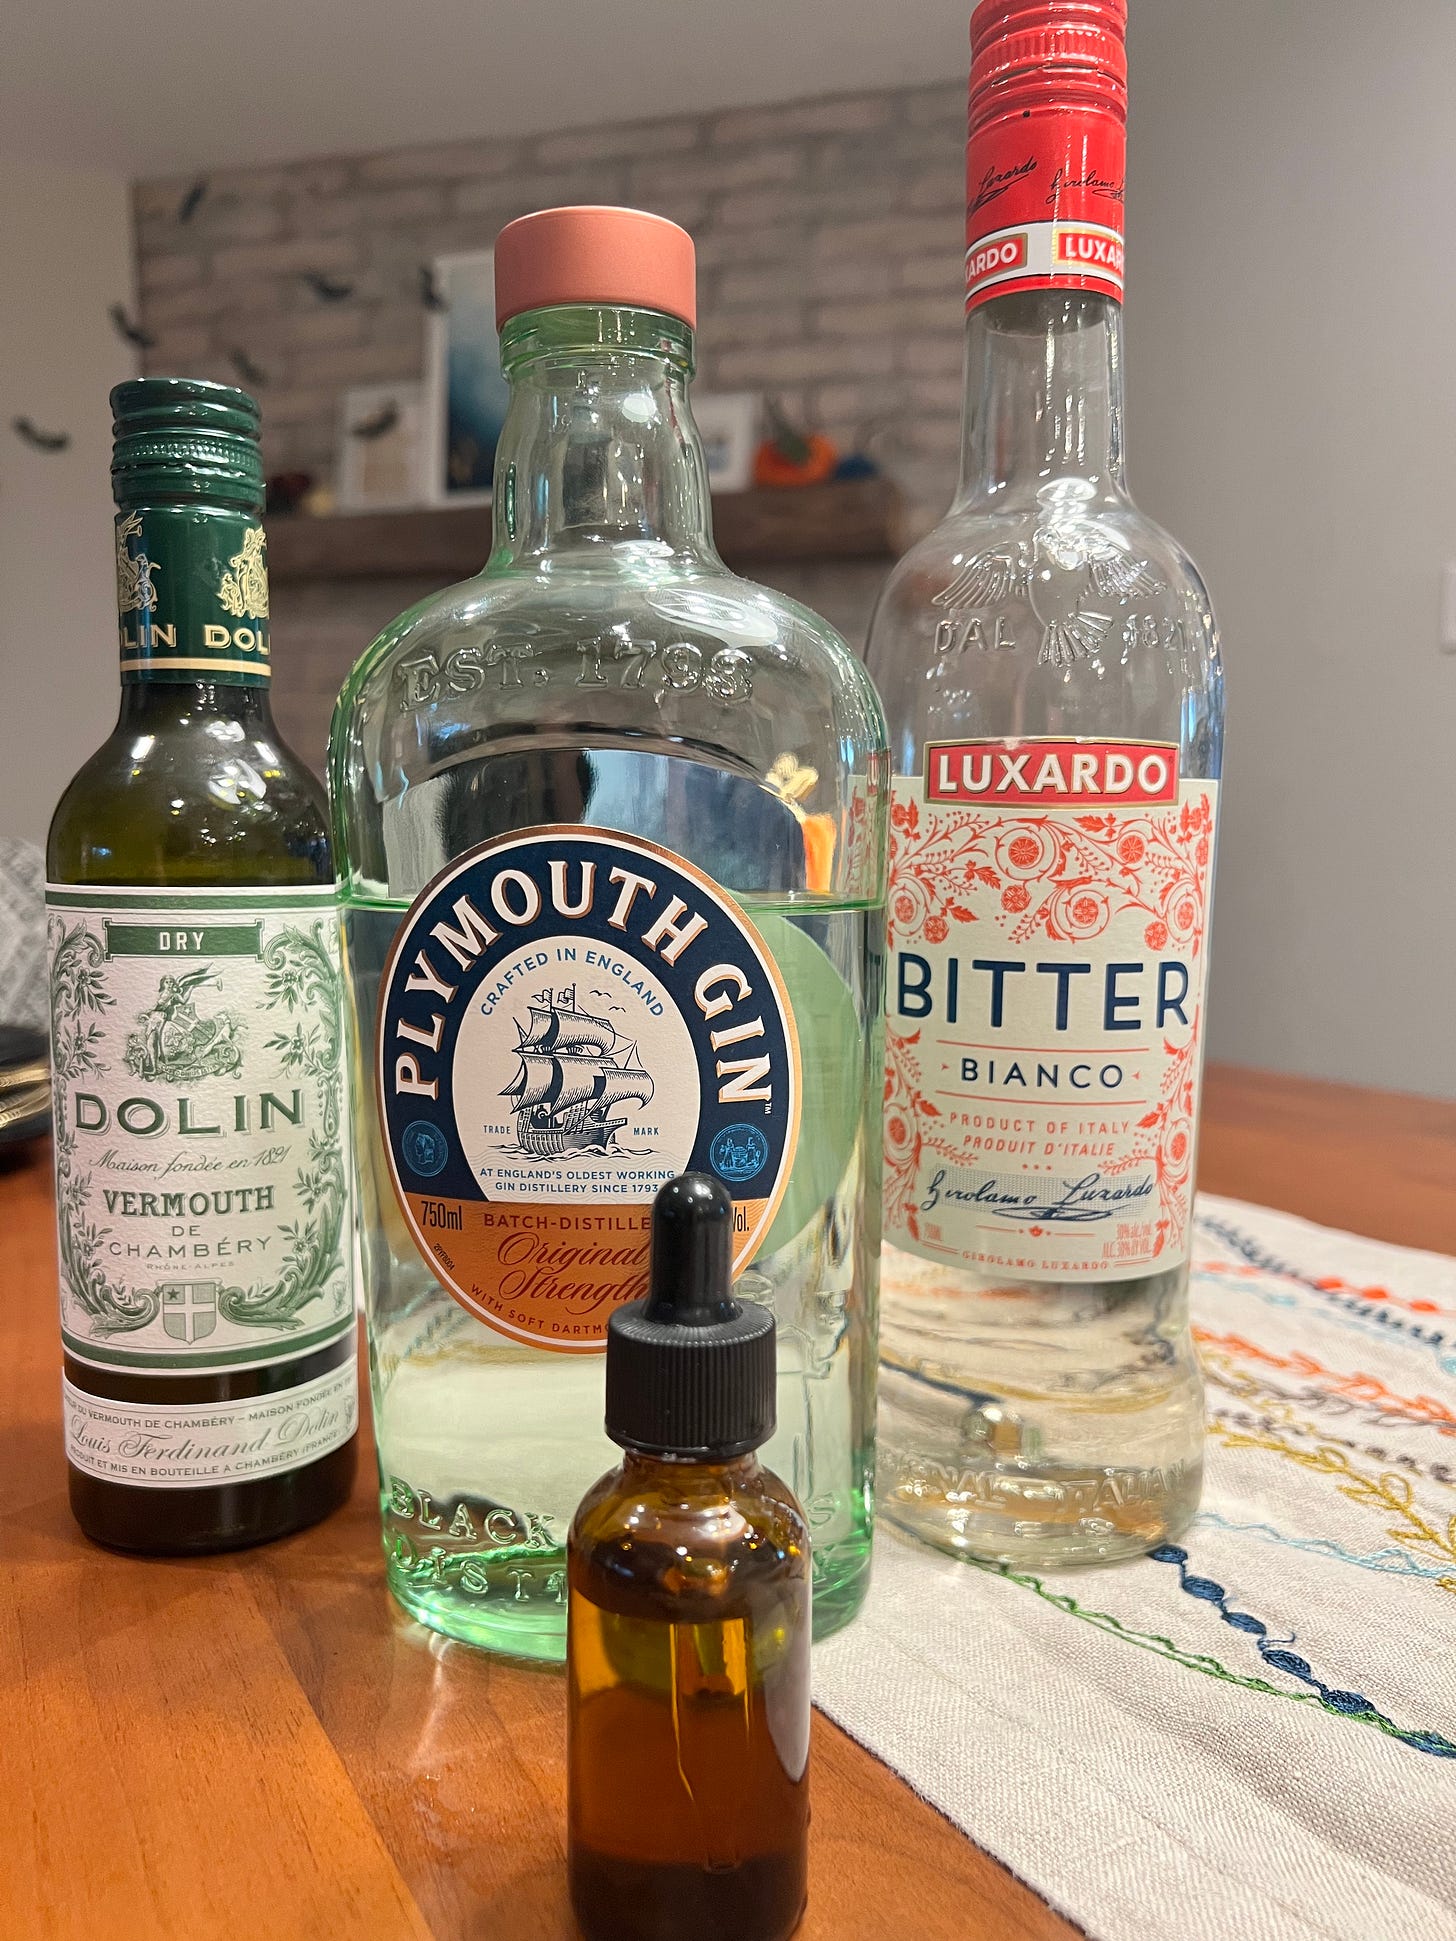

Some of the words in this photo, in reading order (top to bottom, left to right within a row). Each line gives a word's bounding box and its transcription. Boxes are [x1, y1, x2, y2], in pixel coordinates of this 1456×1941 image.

[966, 242, 1018, 280] ARDO
[204, 625, 270, 655] DOL
[932, 617, 1016, 654] DAL
[938, 754, 1168, 794] LUXARDO
[160, 931, 205, 951] DRY
[396, 860, 709, 1101] PLYMOUTH
[694, 963, 772, 1103] GIN
[481, 952, 548, 1015] CRAFTED
[556, 948, 576, 961] IN
[585, 951, 664, 1016] ENGLAND
[897, 951, 1189, 1031] BITTER
[961, 1057, 1123, 1089] BIANCO
[75, 1088, 305, 1139] DOLIN
[951, 1112, 1034, 1134] PRODUCT
[1046, 1121, 1067, 1134] OF
[1079, 1121, 1130, 1134] ITALY
[484, 1125, 511, 1134] TRADE
[633, 1127, 659, 1136] MARK
[962, 1135, 1036, 1155] PRODUIT
[1044, 1142, 1115, 1156] D'ITALIE
[89, 1150, 159, 1172] Maison
[159, 1151, 223, 1181] fondée
[228, 1160, 249, 1169] en
[480, 1168, 493, 1177] AT
[498, 1169, 562, 1179] ENGLAND'S
[567, 1171, 612, 1180] OLDEST
[617, 1170, 675, 1180] WORKING
[103, 1185, 275, 1218] VERMOUTH
[495, 1182, 515, 1191] GIN
[520, 1183, 586, 1193] DISTILLERY
[592, 1184, 628, 1193] SINCE
[632, 1184, 659, 1193] 1793
[920, 1170, 1037, 1211] Girolamo
[172, 1225, 200, 1237] DE
[420, 1201, 463, 1231] 750ml
[110, 1236, 271, 1258] CHAMBÉRY
[497, 1231, 652, 1276] Original
[499, 1266, 651, 1315] Strength
[471, 1284, 503, 1311] WITH
[509, 1309, 544, 1329] SOFT
[552, 1324, 609, 1335] DARTM
[88, 1410, 141, 1427] VERMOUTH
[145, 1420, 160, 1428] DE
[249, 1404, 294, 1421] MAISON
[71, 1414, 111, 1454] Louis
[117, 1430, 271, 1461] Ferdinand
[110, 1462, 128, 1473] MIS
[131, 1466, 146, 1475] EN
[150, 1466, 219, 1476] BOUTEILLE
[390, 1474, 561, 1550] BLACK
